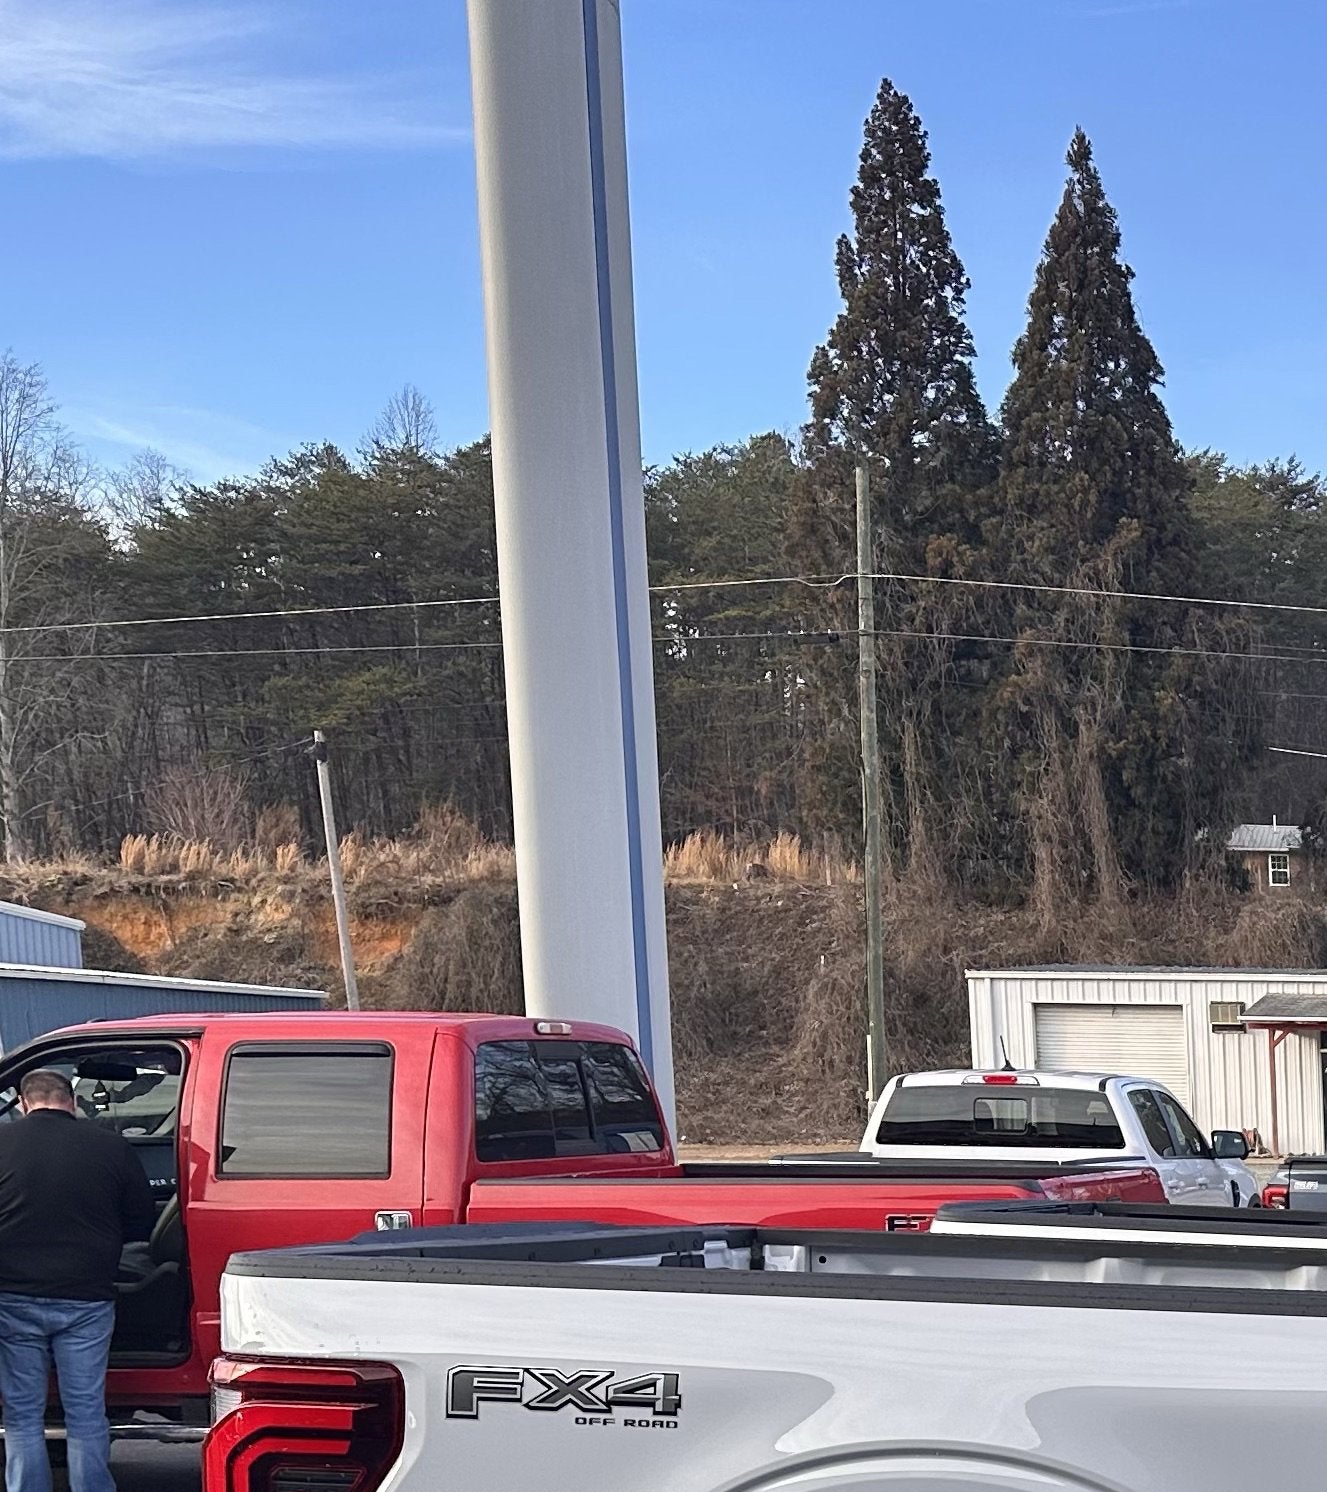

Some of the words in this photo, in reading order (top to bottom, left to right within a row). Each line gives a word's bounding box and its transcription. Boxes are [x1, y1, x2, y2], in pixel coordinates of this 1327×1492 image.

[446, 1364, 682, 1419] FX4
[574, 1416, 616, 1427] OFF
[623, 1418, 679, 1430] ROAD
